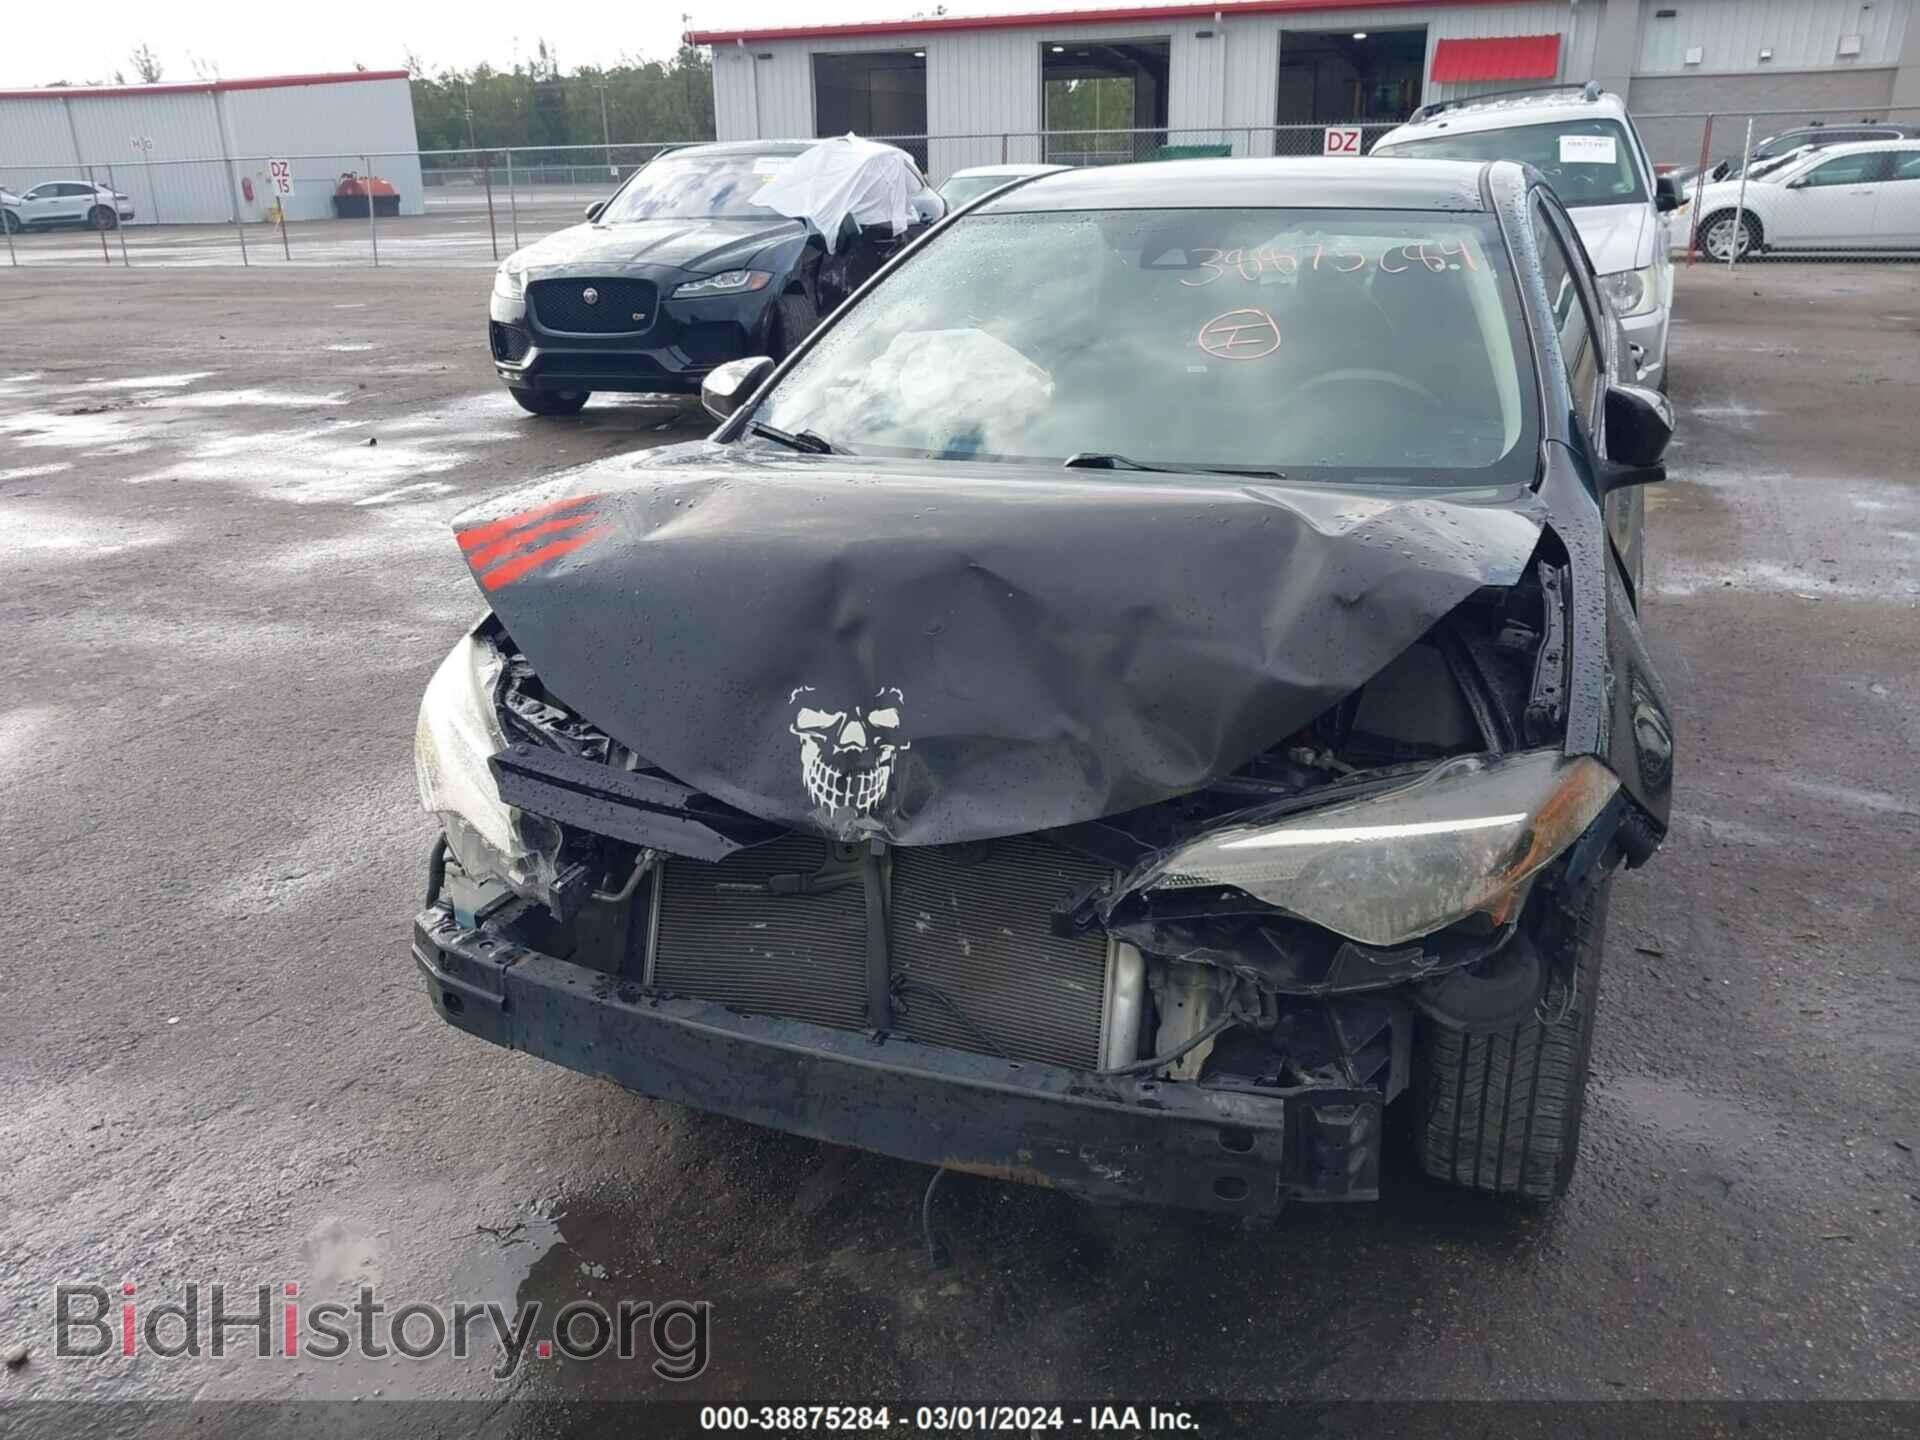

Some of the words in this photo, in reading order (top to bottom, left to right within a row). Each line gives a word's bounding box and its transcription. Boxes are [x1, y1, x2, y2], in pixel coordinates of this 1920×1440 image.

[1328, 131, 1359, 151] DZ
[271, 161, 289, 177] DZ
[277, 179, 290, 193] 15
